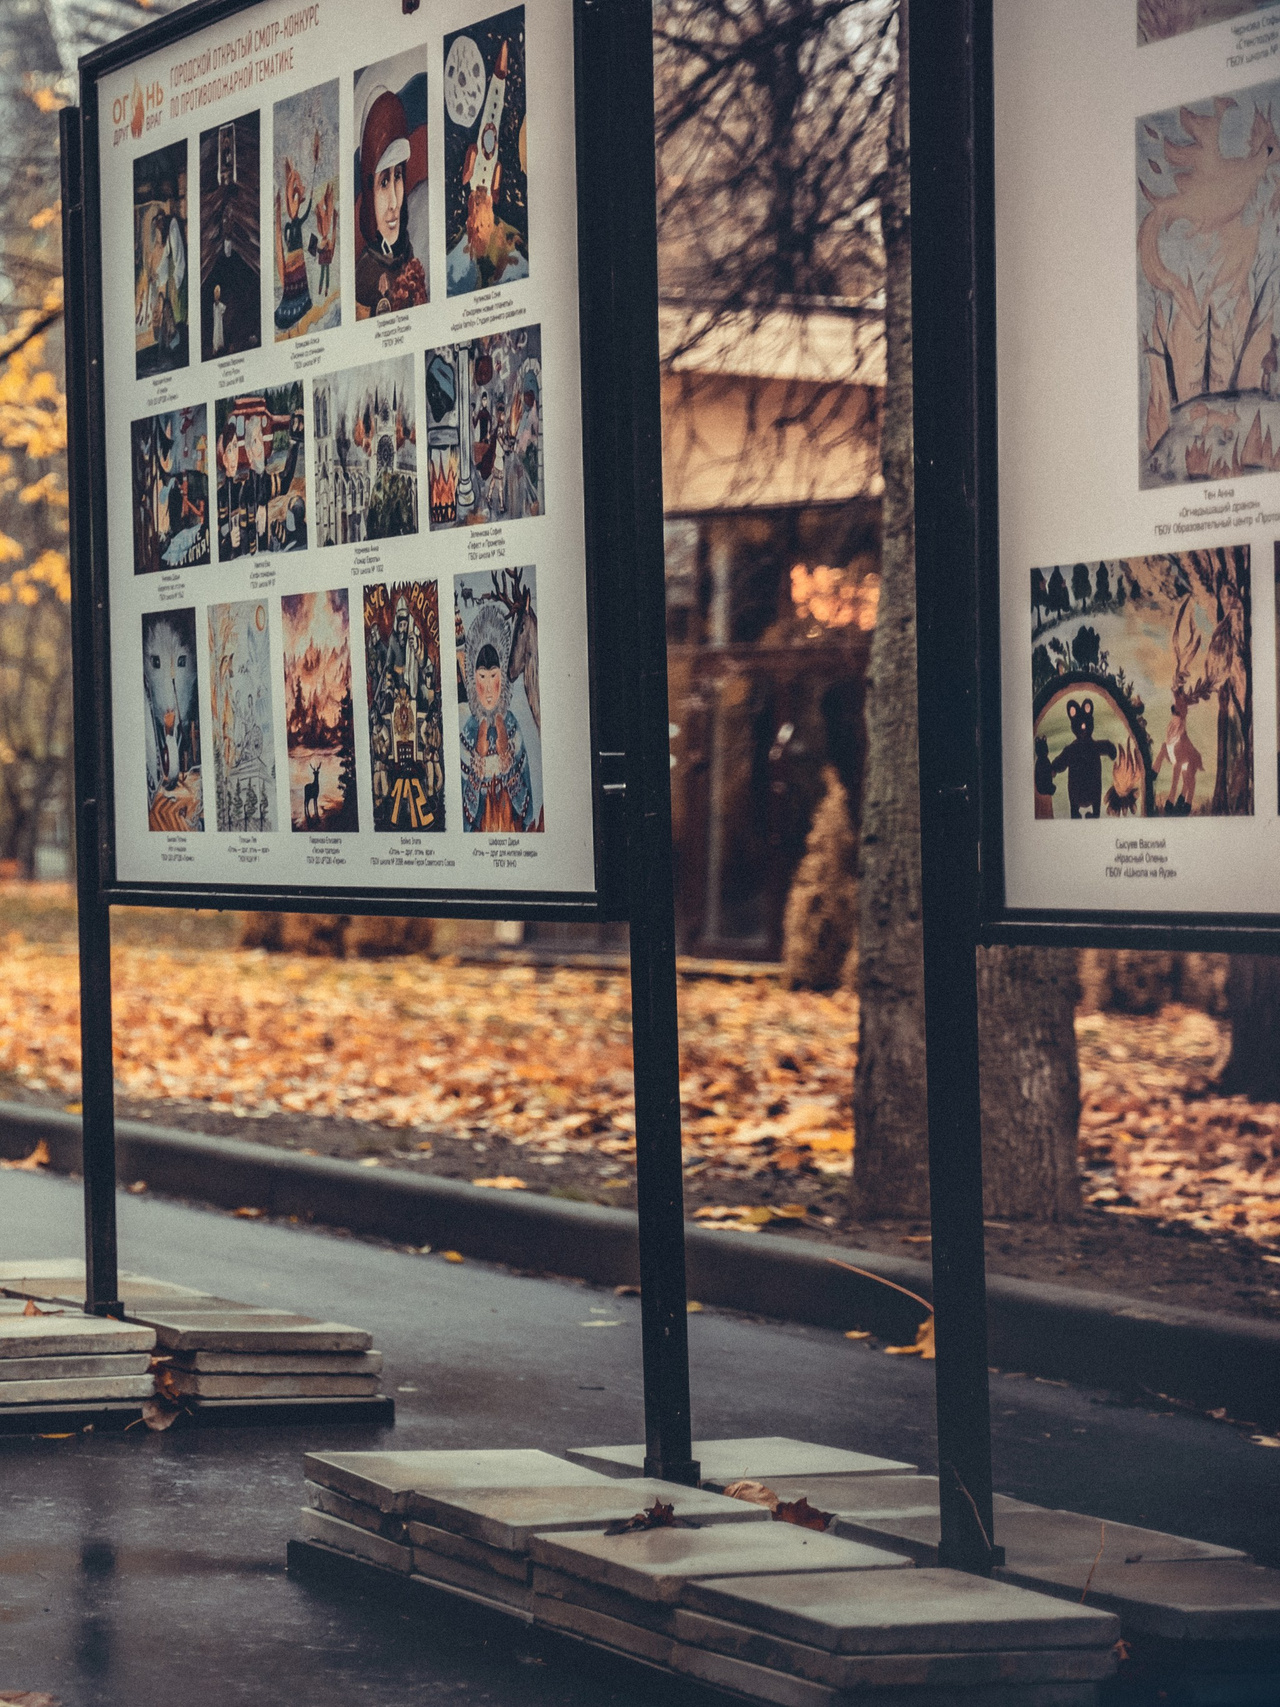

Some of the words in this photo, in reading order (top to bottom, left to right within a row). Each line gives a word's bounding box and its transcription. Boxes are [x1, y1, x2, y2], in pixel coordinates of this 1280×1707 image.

[170, 48, 212, 89] ГОРОДСКОЙ
[213, 30, 252, 69] ОТКРЫТЫЙ
[254, 3, 320, 52] СМОТР-КОНКУРС
[170, 94, 181, 119] ПО
[181, 59, 254, 113] ПРОТИВОПОЖАРНОЙ
[255, 46, 294, 83] ТЕМАТИКЕ
[146, 110, 163, 132] ВРАГ
[391, 778, 434, 828] 112
